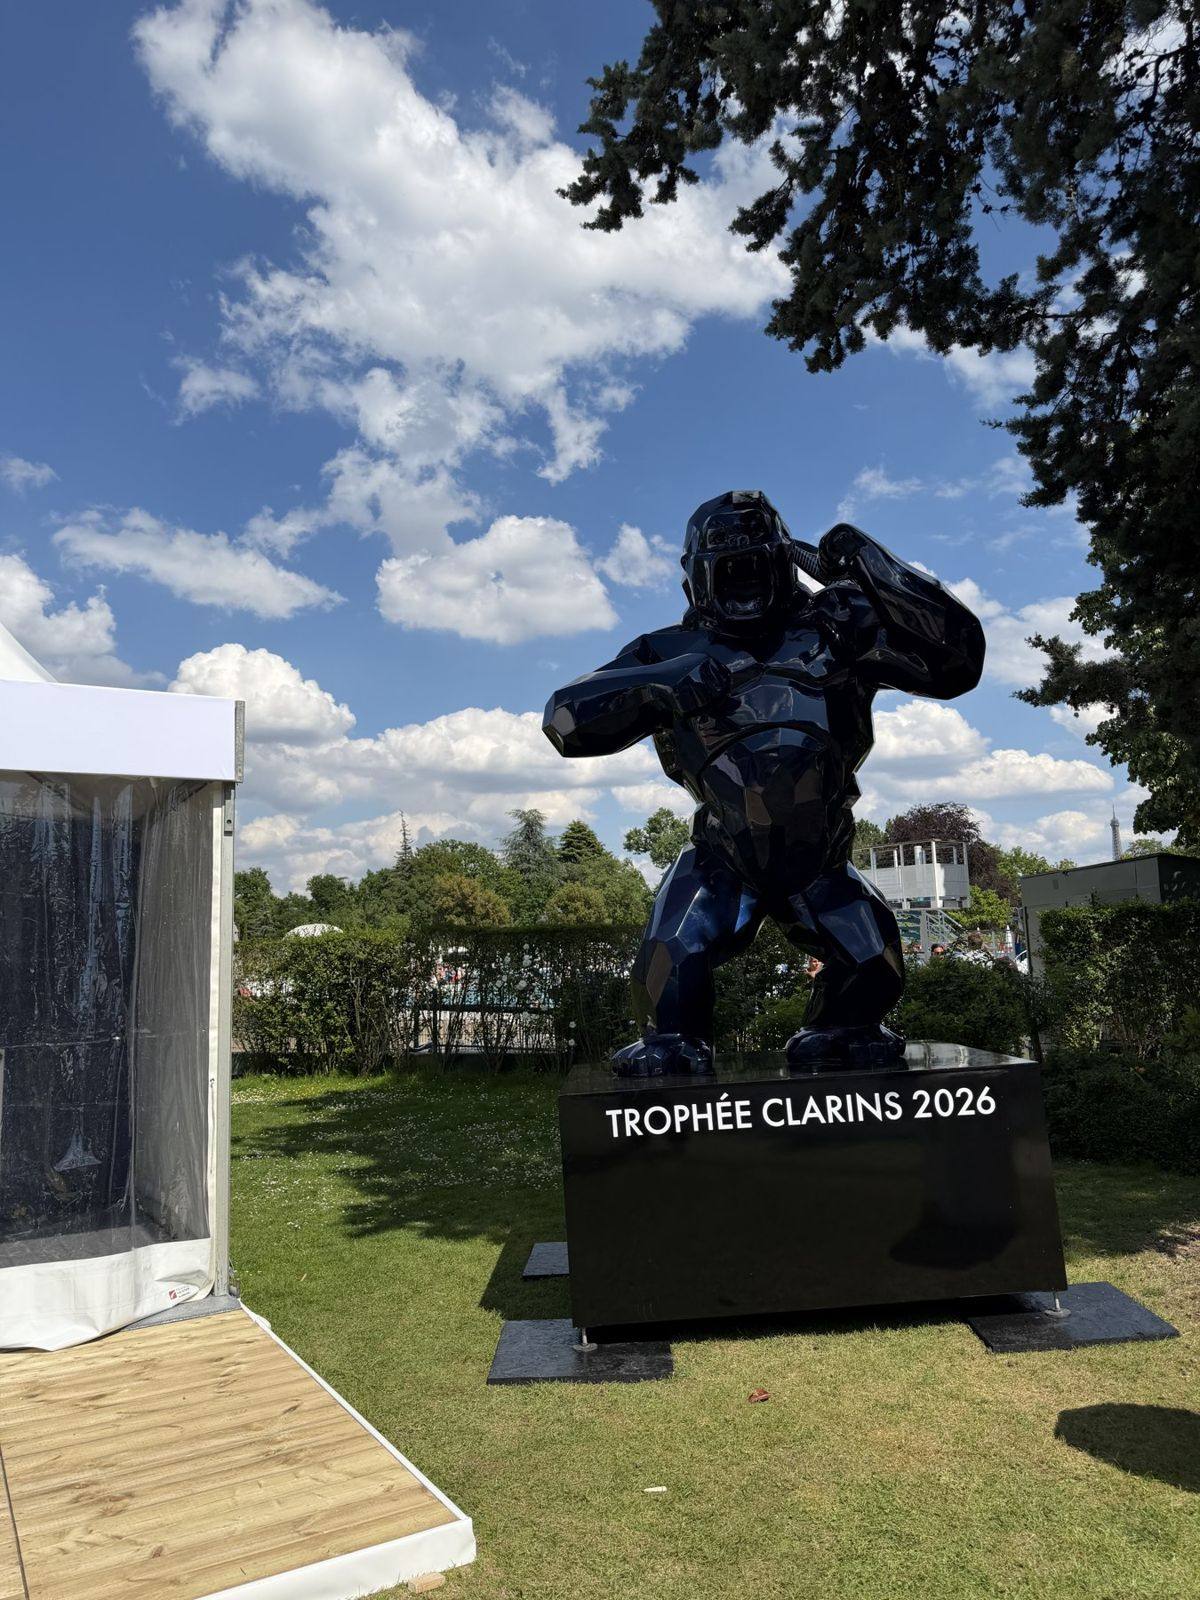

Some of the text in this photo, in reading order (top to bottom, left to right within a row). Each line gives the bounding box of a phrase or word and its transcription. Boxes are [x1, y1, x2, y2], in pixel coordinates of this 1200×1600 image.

[606, 1085, 996, 1138] TROPHÉE CLARINS 2026
